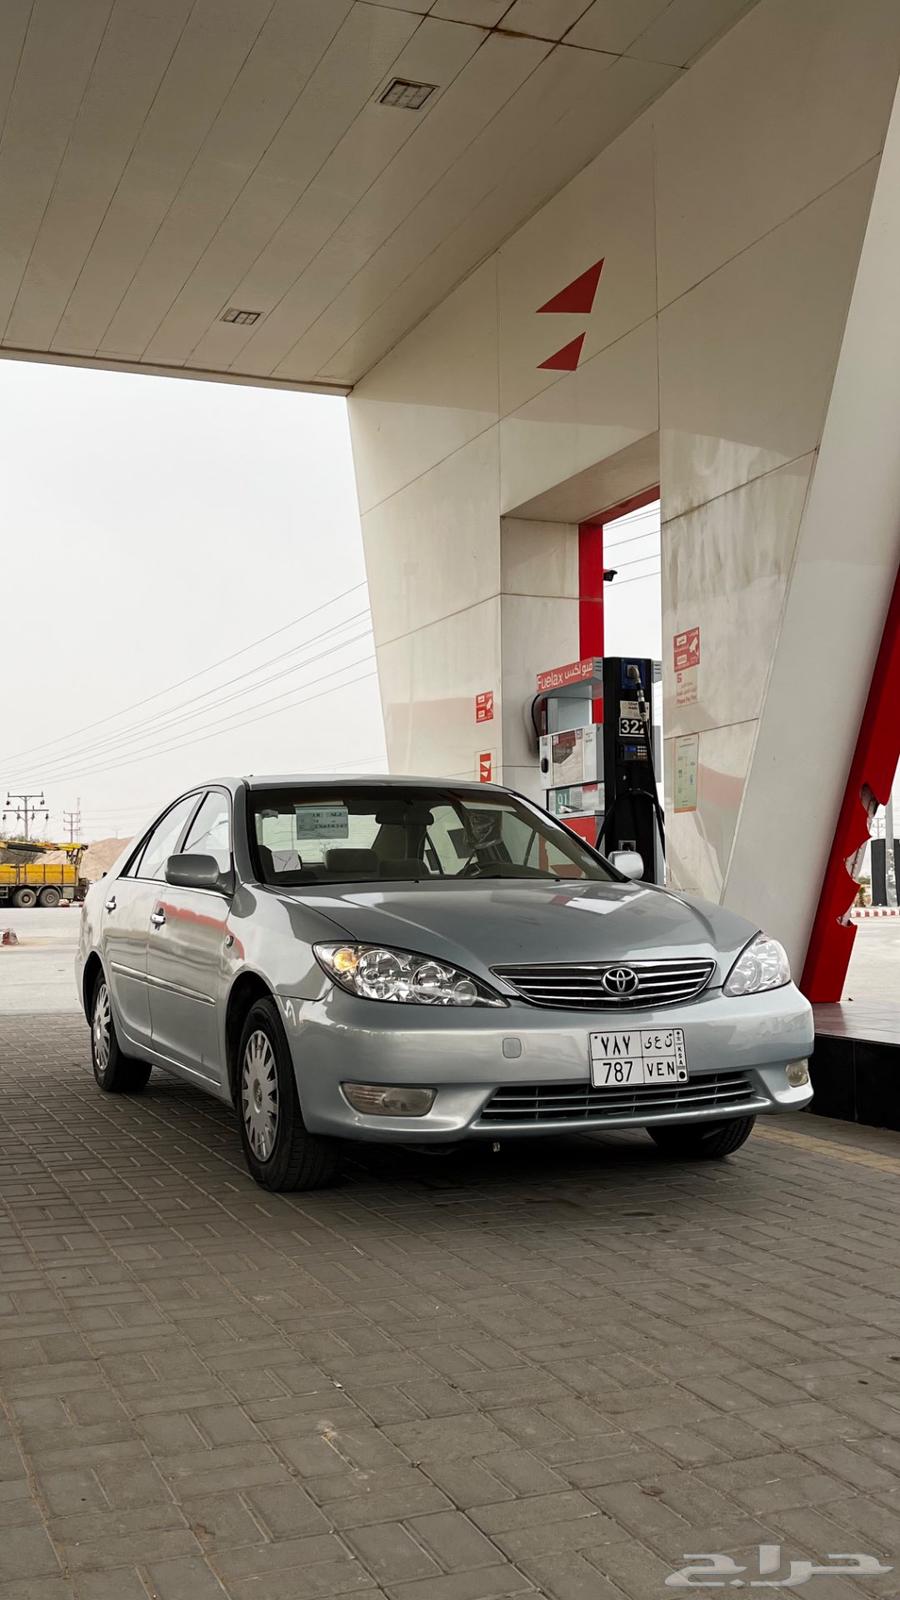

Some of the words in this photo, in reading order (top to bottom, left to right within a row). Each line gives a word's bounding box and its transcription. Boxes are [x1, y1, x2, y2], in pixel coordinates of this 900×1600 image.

[537, 672, 563, 689] Fuelax
[602, 1061, 633, 1084] 787
[646, 1061, 675, 1077] VEN
